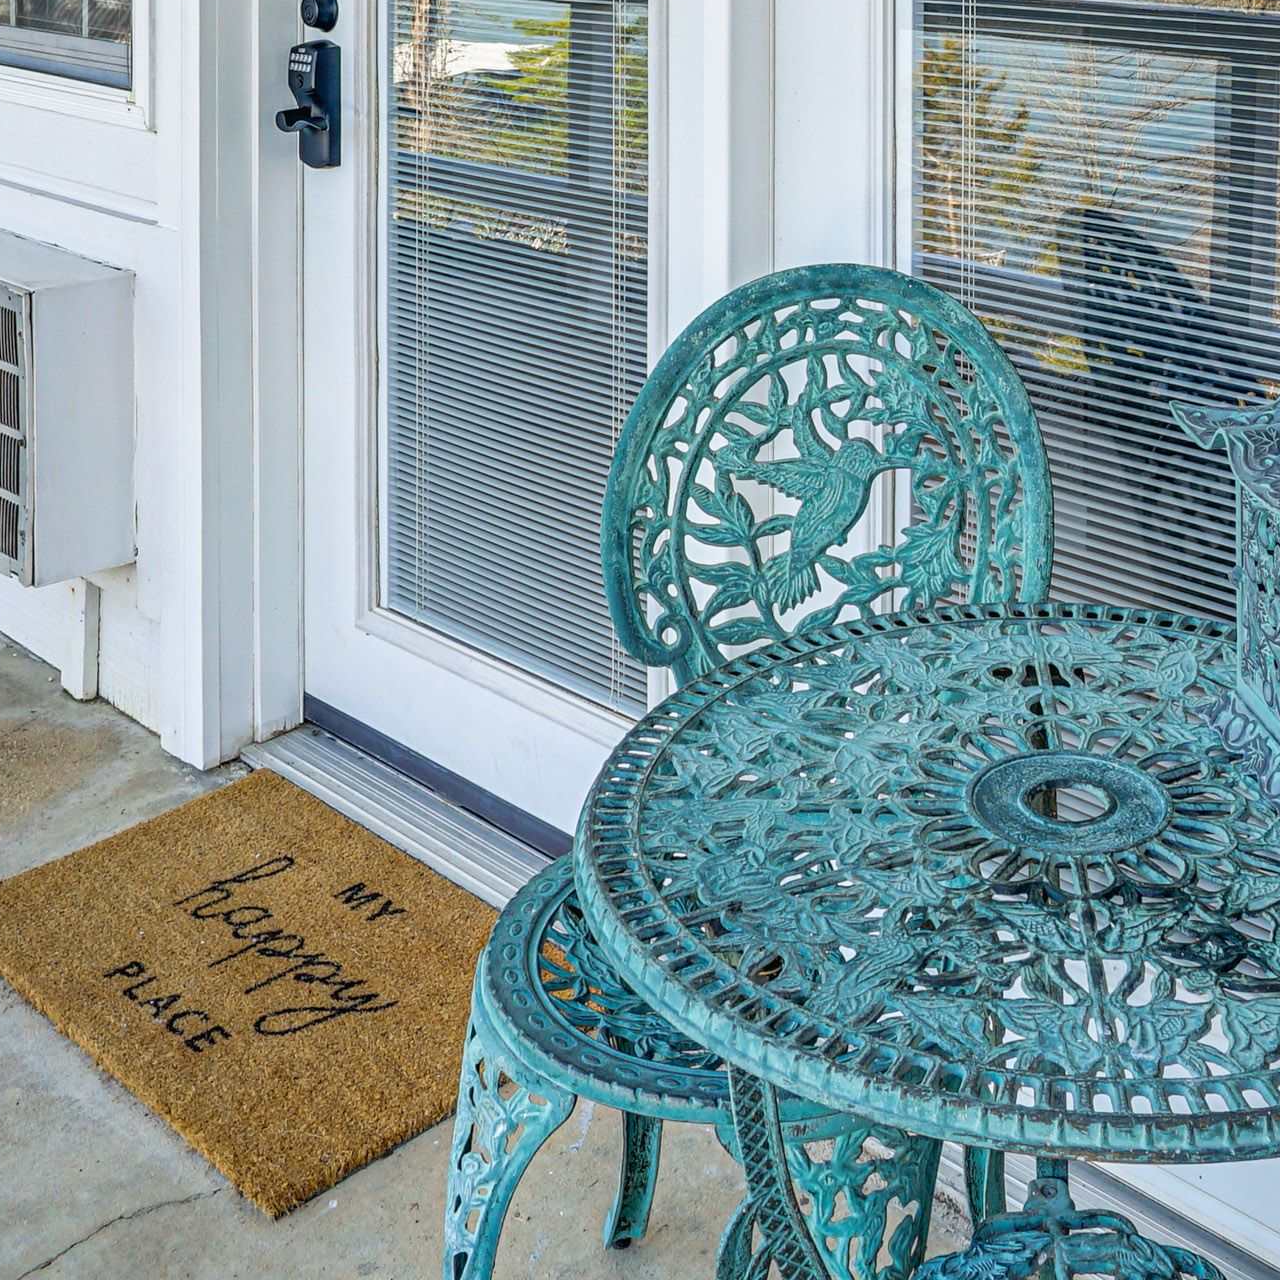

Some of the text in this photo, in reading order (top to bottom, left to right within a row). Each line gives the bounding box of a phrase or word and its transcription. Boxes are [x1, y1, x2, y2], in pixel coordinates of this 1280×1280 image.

[173, 855, 398, 1036] happy
[333, 883, 407, 921] MY
[104, 961, 231, 1052] PLACE
